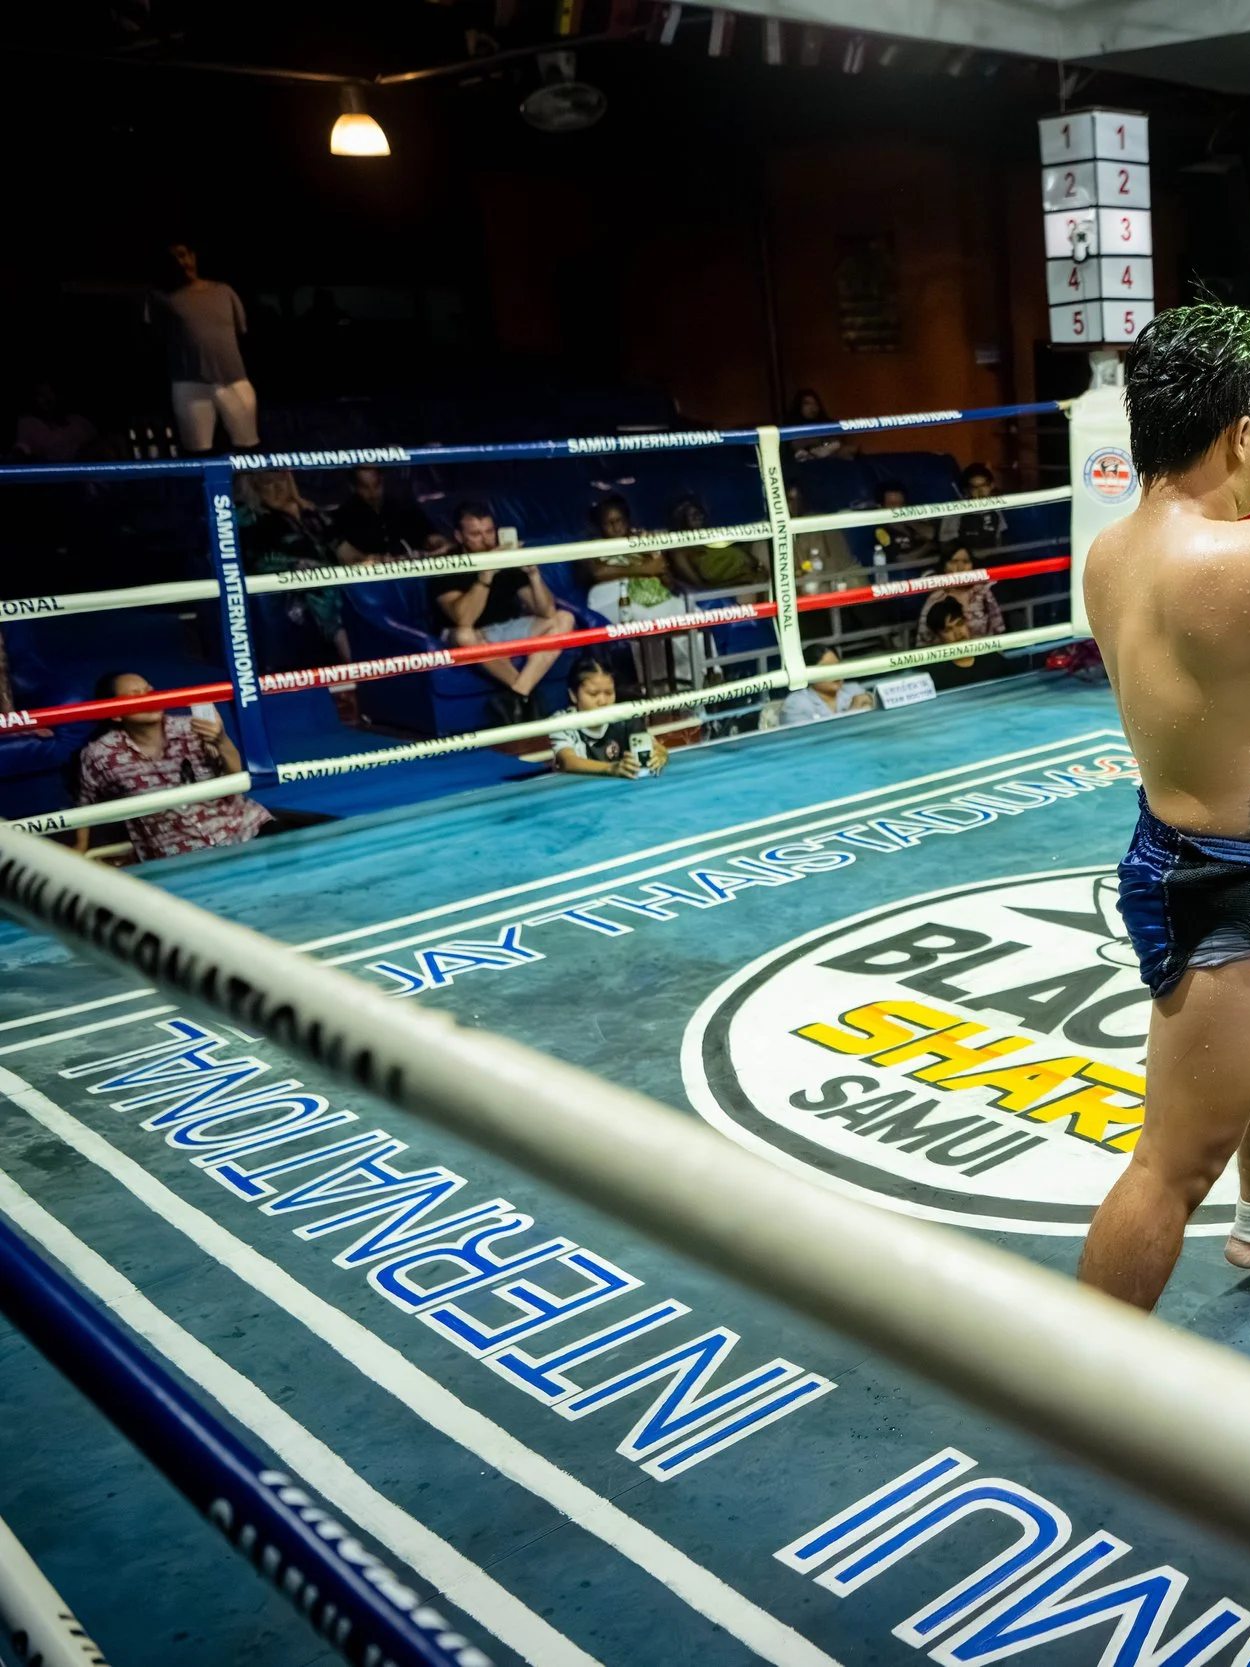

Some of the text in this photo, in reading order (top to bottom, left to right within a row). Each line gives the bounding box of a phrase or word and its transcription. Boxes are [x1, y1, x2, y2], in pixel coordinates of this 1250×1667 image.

[1061, 124, 1071, 149] 1
[1116, 125, 1125, 150] 1
[1064, 172, 1076, 197] 2
[1118, 170, 1129, 194] 2
[1121, 217, 1131, 241] 3
[1068, 267, 1080, 290] 4
[1121, 265, 1132, 289] 4
[1073, 311, 1084, 335] 5
[1124, 311, 1135, 334] 5
[839, 416, 879, 430] SAMUI
[567, 430, 724, 453] SAMUI INTERNATIONAL
[230, 446, 411, 469] MUI INTERNATIONAL
[677, 523, 772, 543] INTERNATIONA
[768, 466, 794, 631] SAMUI INTERNATIONAL
[278, 554, 478, 584] SAMUI INTERNATIONAL
[213, 494, 258, 708] SAMUI INTERNATIONAL
[872, 582, 909, 597] SAMUI
[606, 604, 758, 638] SAMUI INTERNATIONAL
[319, 650, 455, 683] INTERNATIONAL
[890, 640, 1003, 668] SAMUI INTERNATIONAL
[815, 921, 1151, 1050] BLAC
[789, 1000, 1147, 1155] SHAR
[789, 1074, 1048, 1178] SAMUI
[58, 1016, 838, 1482] INTERNATIONAL
